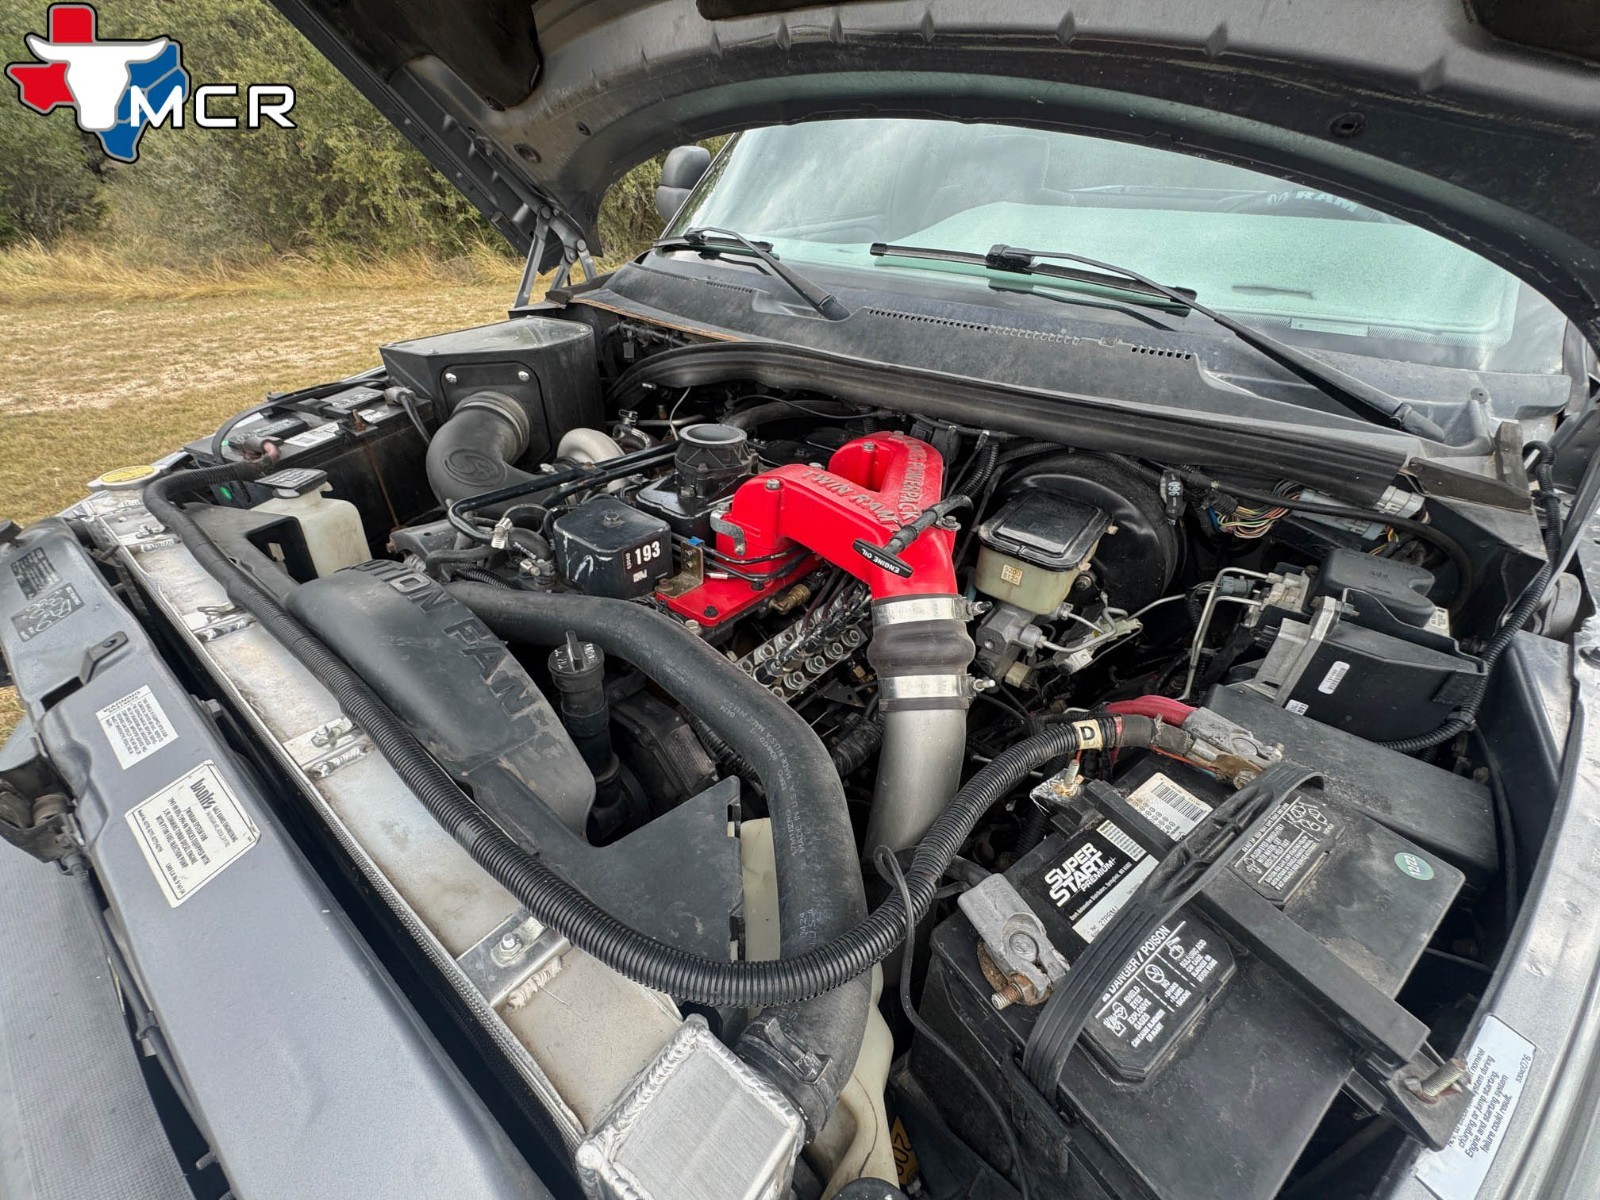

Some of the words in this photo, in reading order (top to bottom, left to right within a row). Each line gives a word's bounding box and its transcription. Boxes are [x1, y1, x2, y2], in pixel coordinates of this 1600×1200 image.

[1295, 190, 1358, 212] RAM
[801, 469, 854, 497] TWIN
[849, 493, 897, 524] RAM
[898, 461, 924, 521] POWERPACK
[635, 541, 660, 564] 193
[859, 548, 873, 558] OIL
[872, 555, 900, 574] ENGINE
[441, 615, 540, 721] FAN
[1079, 725, 1095, 740] D
[189, 777, 218, 811] banks
[1042, 841, 1097, 889] SUPER
[1048, 850, 1104, 907] START
[1404, 855, 1420, 875] 12/22
[1107, 957, 1140, 994] DANGER
[1141, 924, 1170, 956] POISON
[1126, 997, 1151, 1024] EXPLOSIVE
[1133, 1011, 1150, 1030] GASES
[1471, 1046, 1484, 1071] nominal
[1480, 1055, 1495, 1074] during
[1458, 1118, 1477, 1147] charging
[1473, 1095, 1488, 1113] jump
[1464, 1134, 1480, 1157] Engine
[1476, 1119, 1487, 1135] and
[1483, 1096, 1500, 1122] starting
[1494, 1074, 1508, 1096] system
[1480, 1130, 1495, 1153] failure
[1490, 1111, 1503, 1131] could
